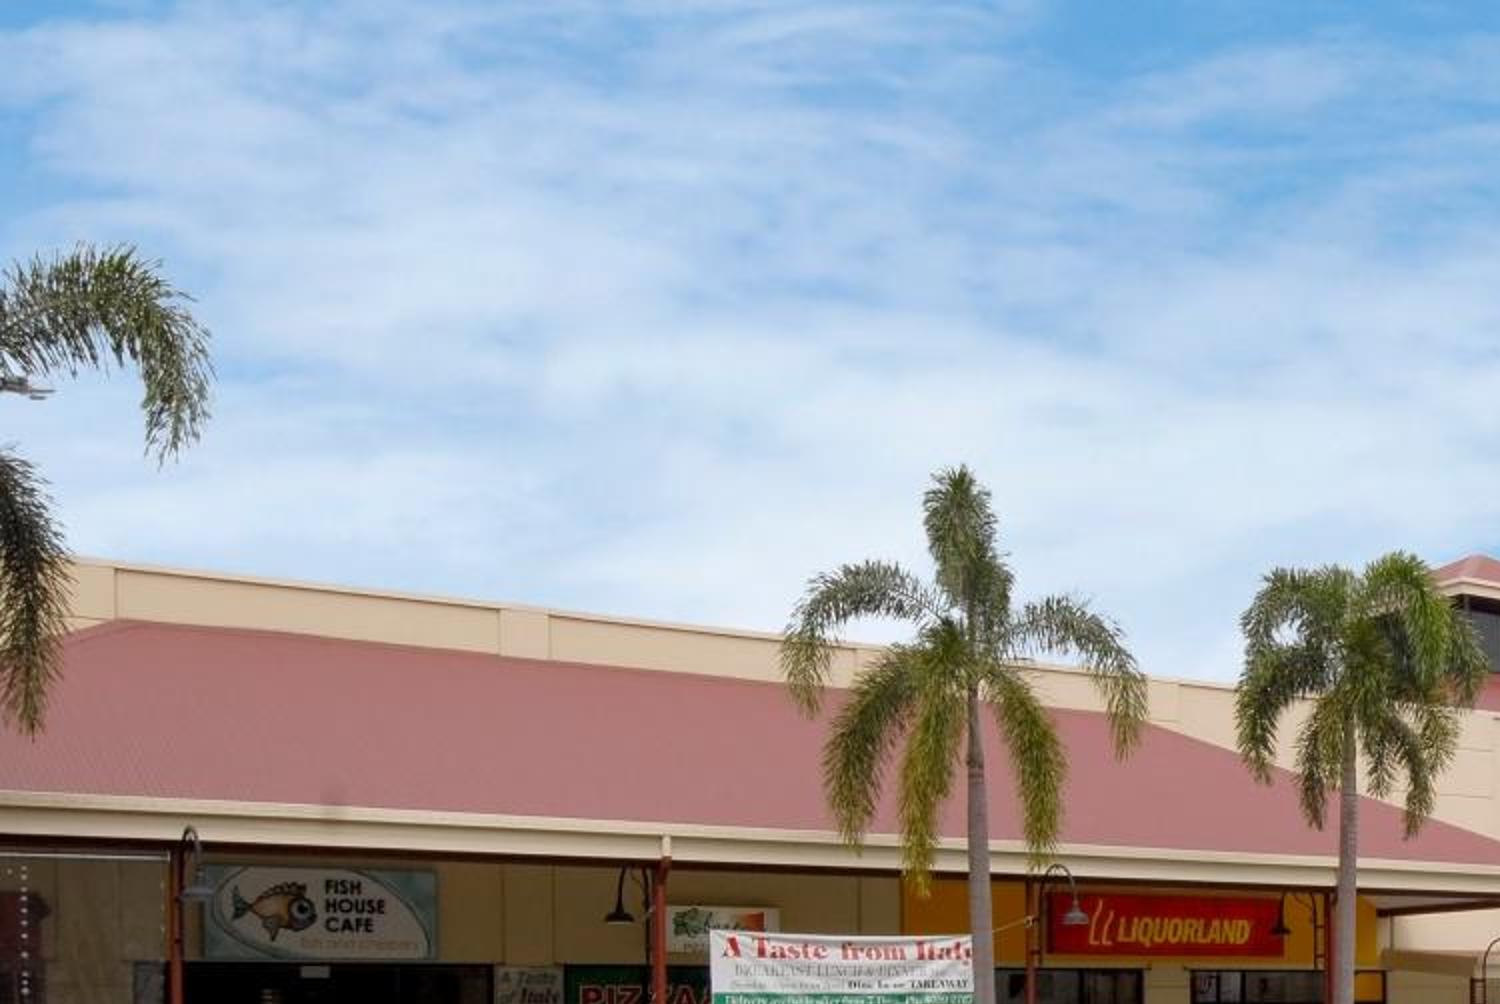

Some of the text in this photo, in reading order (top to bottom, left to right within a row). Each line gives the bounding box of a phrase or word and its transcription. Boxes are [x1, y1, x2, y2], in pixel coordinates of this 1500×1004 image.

[325, 879, 363, 895] FISH
[325, 898, 385, 915] HOUSE
[325, 917, 374, 933] CAFE
[1117, 914, 1251, 948] LIQUORLAND
[721, 936, 742, 959] A
[751, 935, 828, 960] Taste
[841, 942, 907, 961] from
